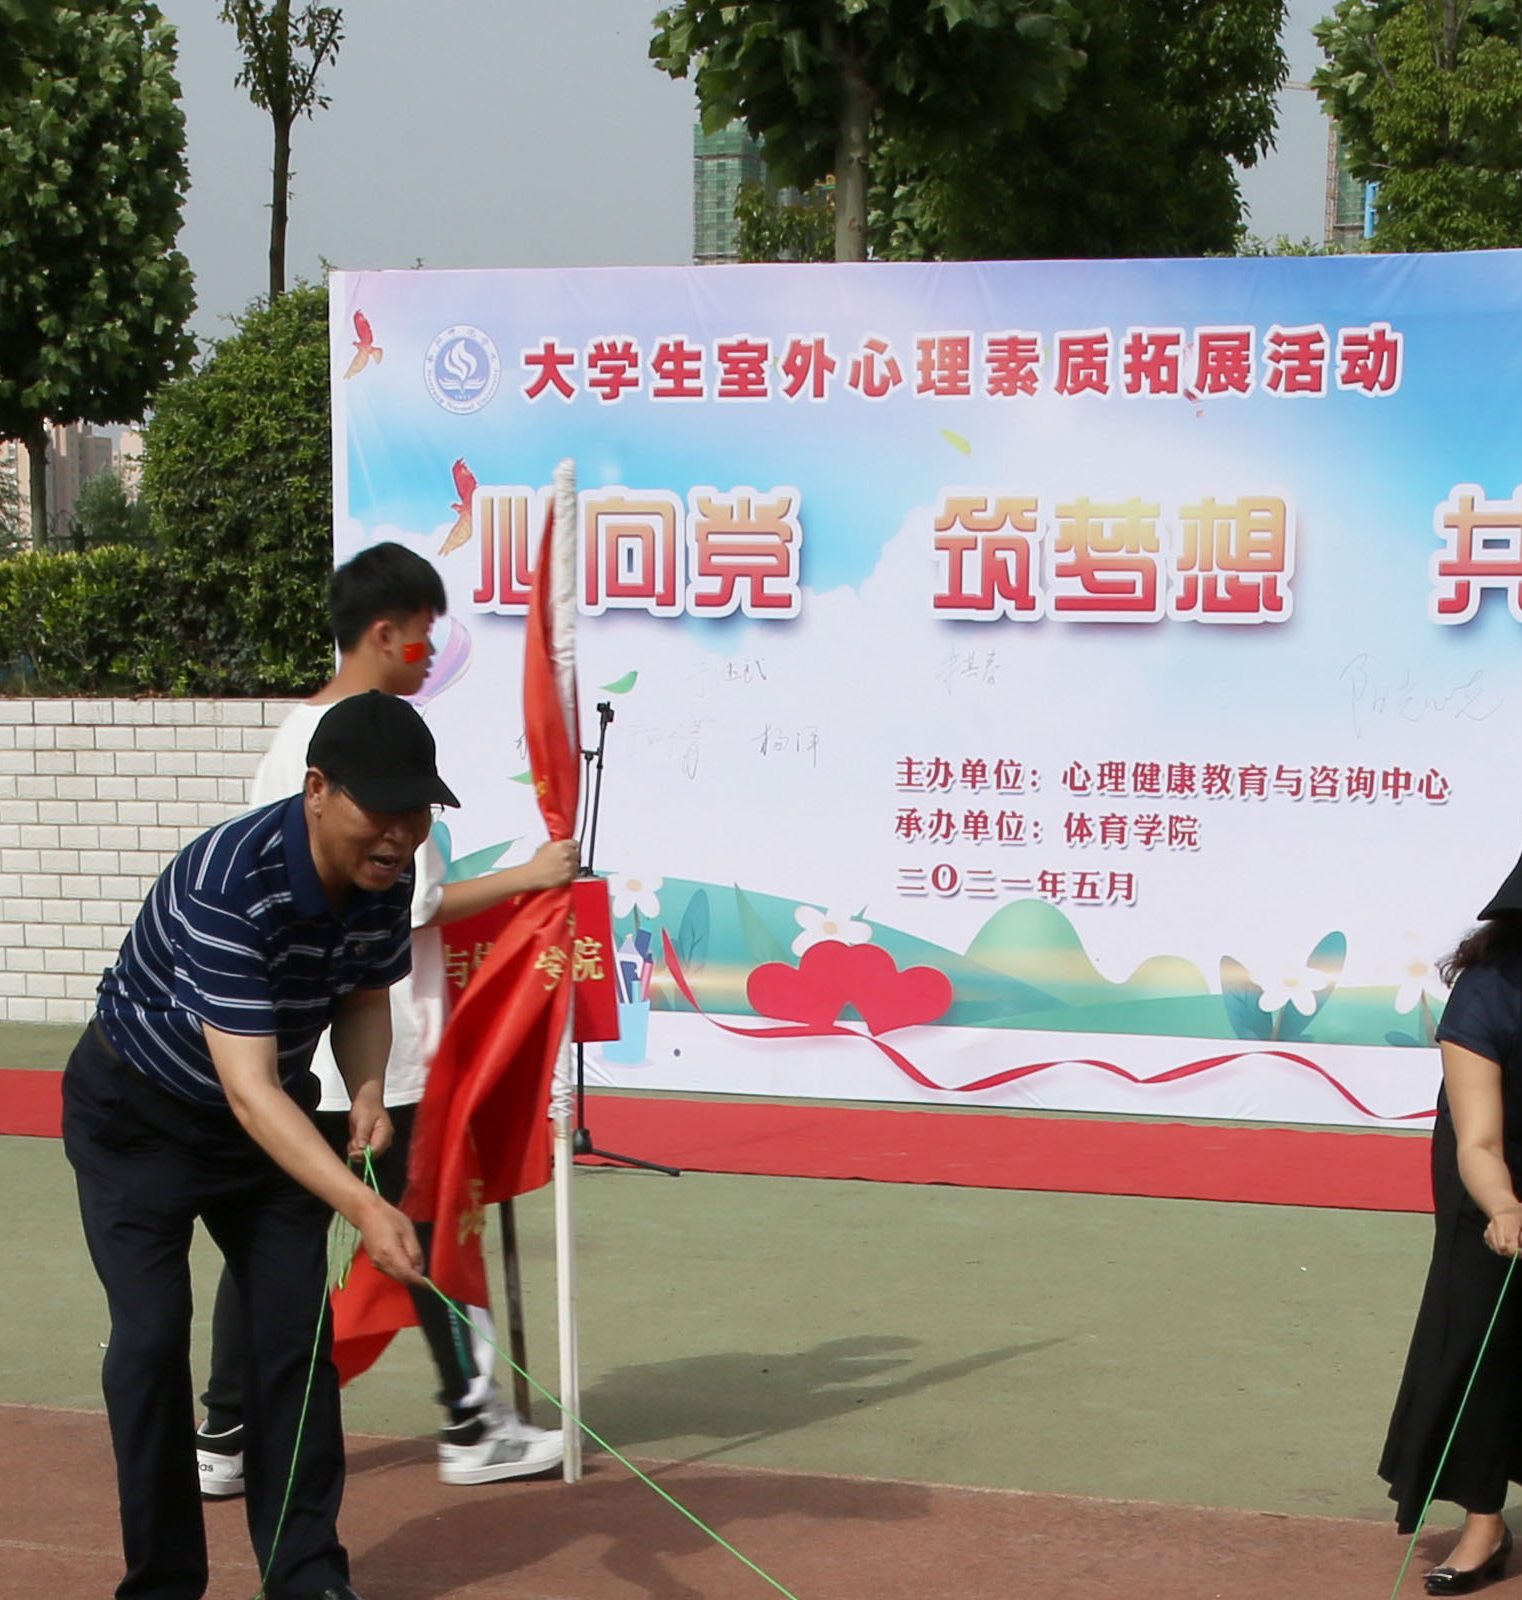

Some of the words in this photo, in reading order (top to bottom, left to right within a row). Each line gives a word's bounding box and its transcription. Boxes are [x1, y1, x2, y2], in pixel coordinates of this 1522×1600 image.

[523, 327, 1402, 399] 大学生室外心理素质拓展活动
[933, 492, 1286, 614] 筑梦想
